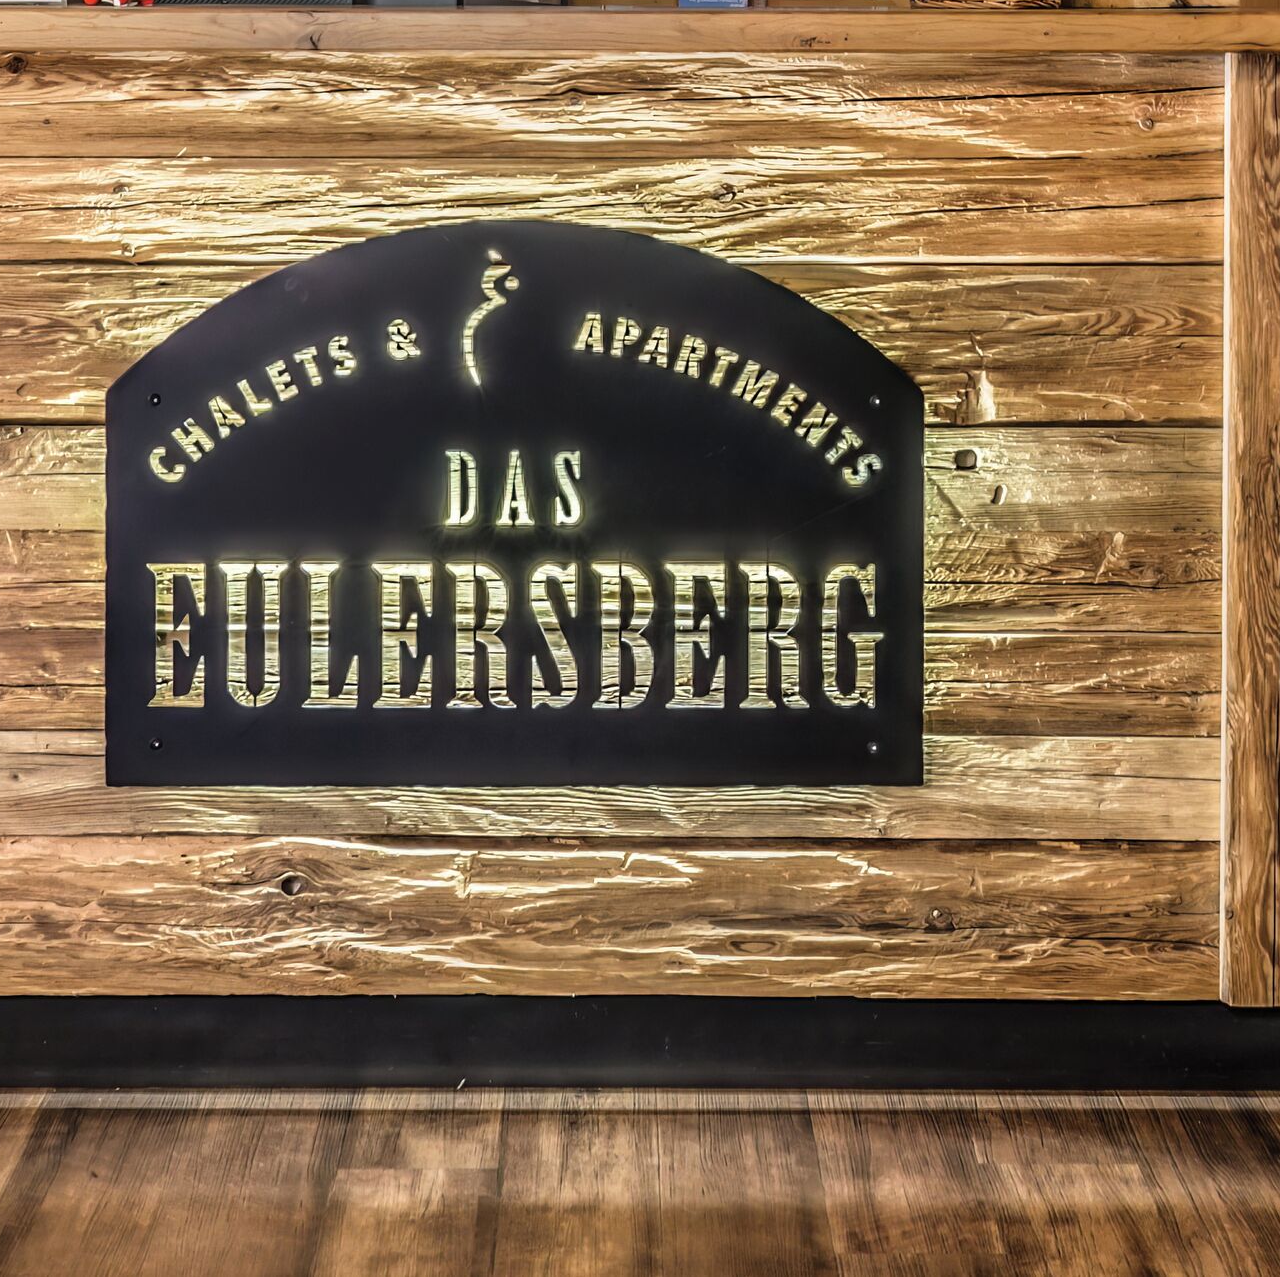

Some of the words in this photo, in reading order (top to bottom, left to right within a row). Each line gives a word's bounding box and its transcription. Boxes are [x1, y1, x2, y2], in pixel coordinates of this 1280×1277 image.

[148, 335, 357, 484] CHALETS
[386, 318, 422, 362] &
[573, 311, 884, 487] APARTMENTS
[444, 449, 586, 526] DAS
[145, 561, 885, 709] EULERSBERG
